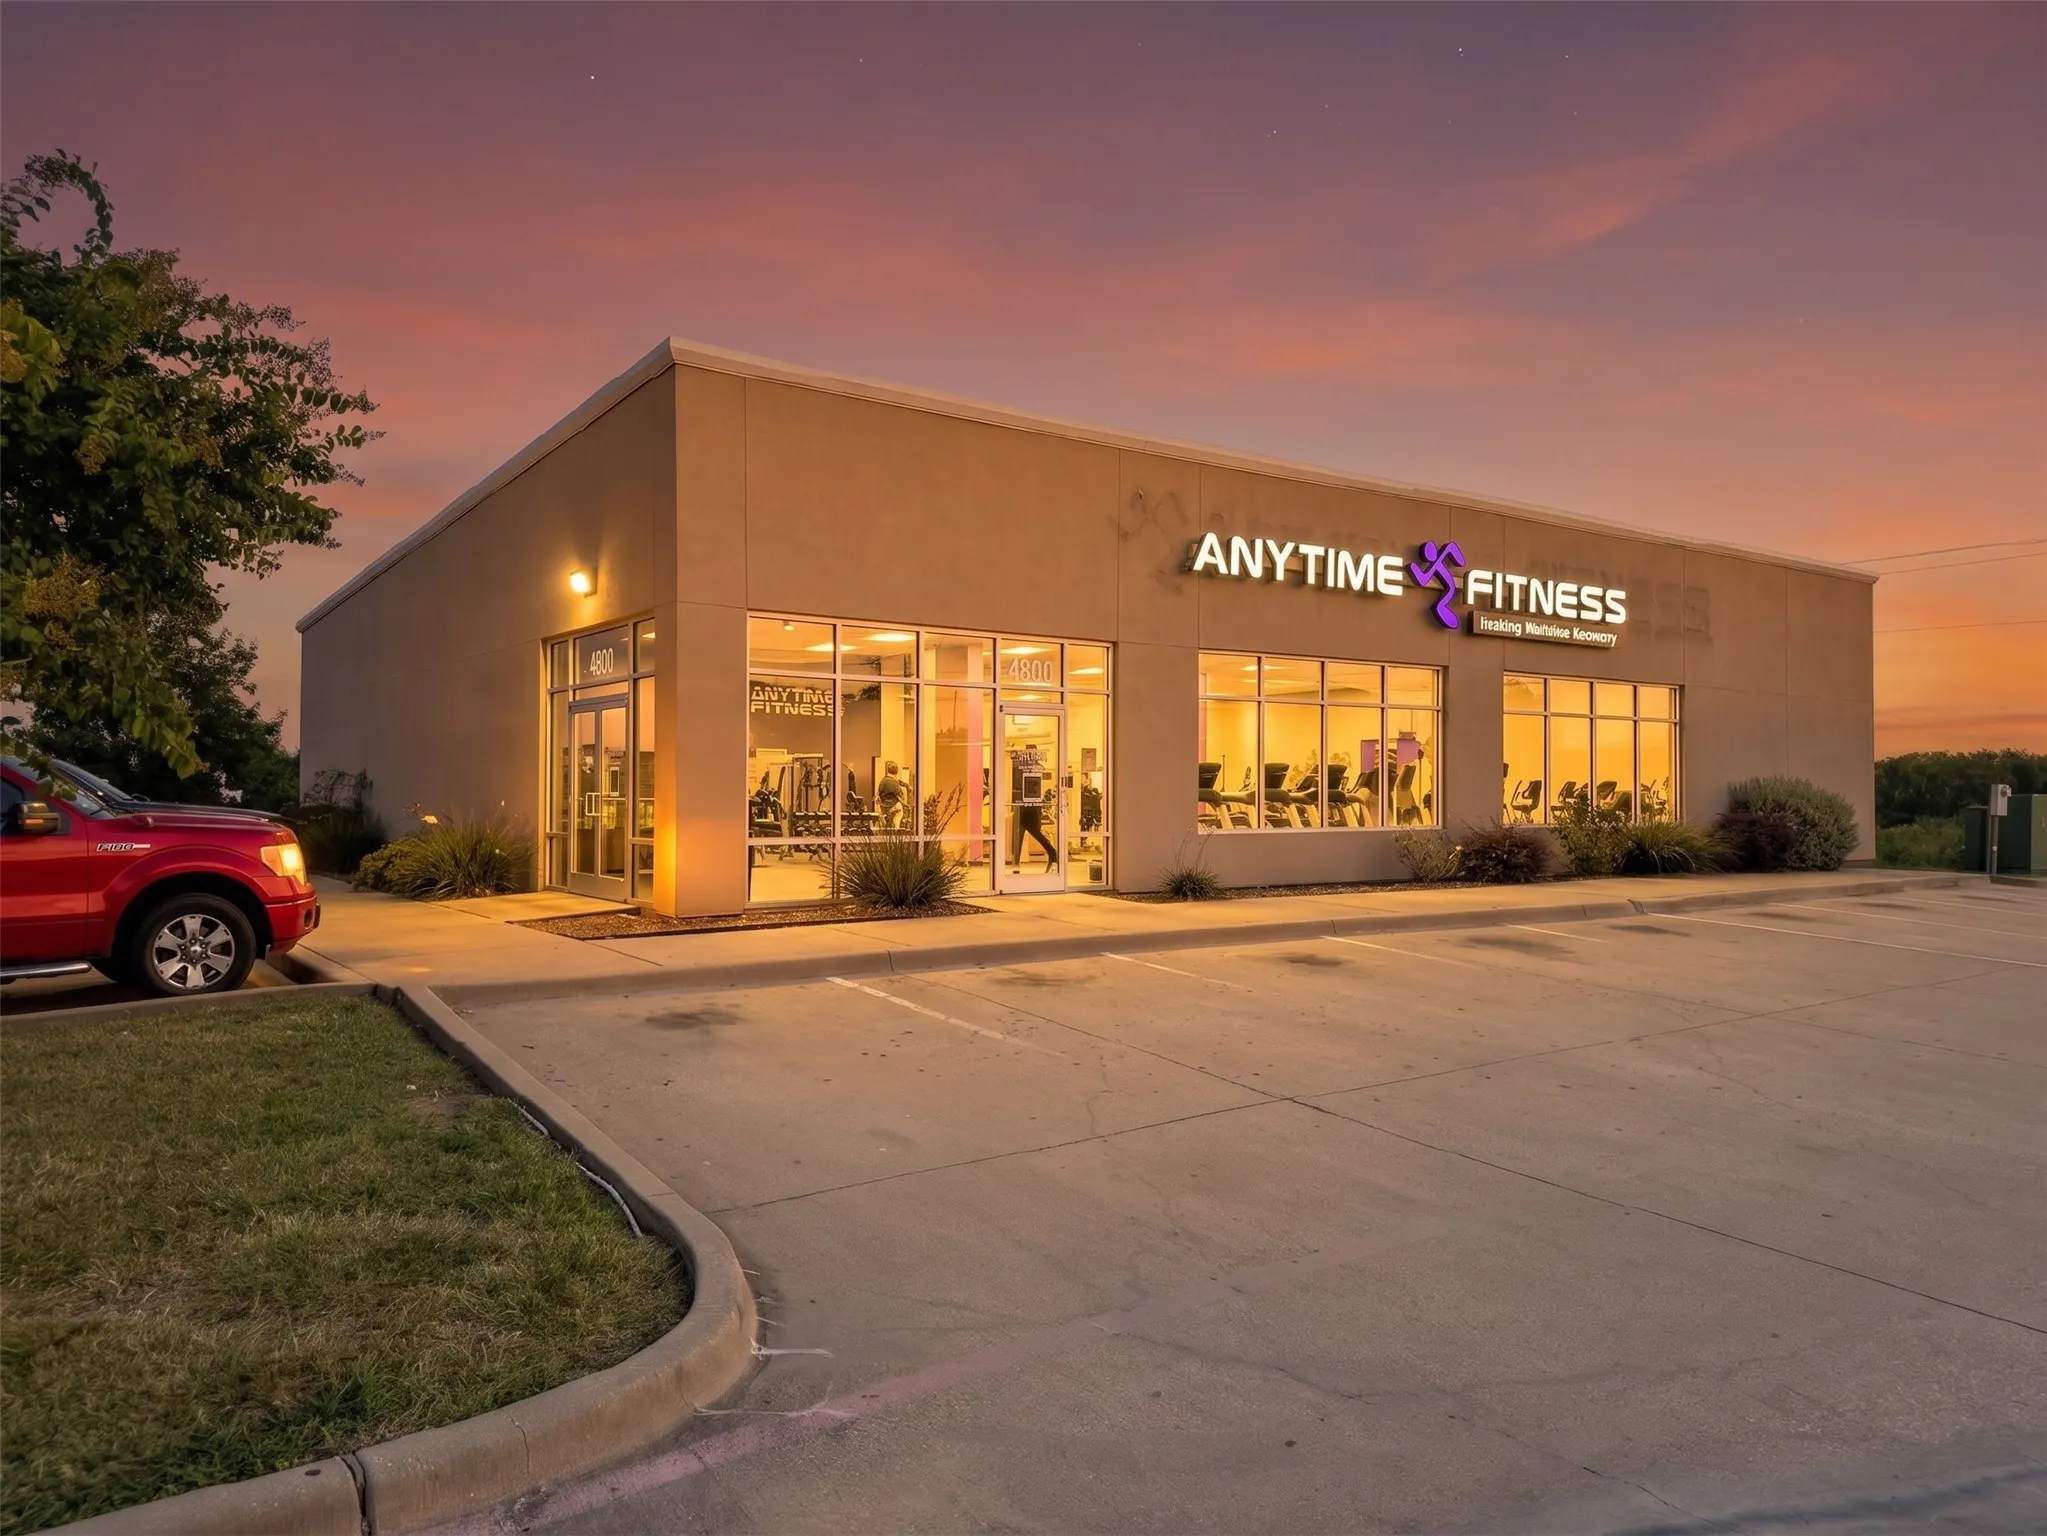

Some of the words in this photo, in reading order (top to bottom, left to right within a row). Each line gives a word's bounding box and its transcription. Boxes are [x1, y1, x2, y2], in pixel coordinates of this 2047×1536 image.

[1192, 531, 1404, 597] ANYTIME
[1466, 568, 1628, 625] FITNESS
[589, 647, 614, 676] 4800
[1008, 656, 1053, 682] 4800
